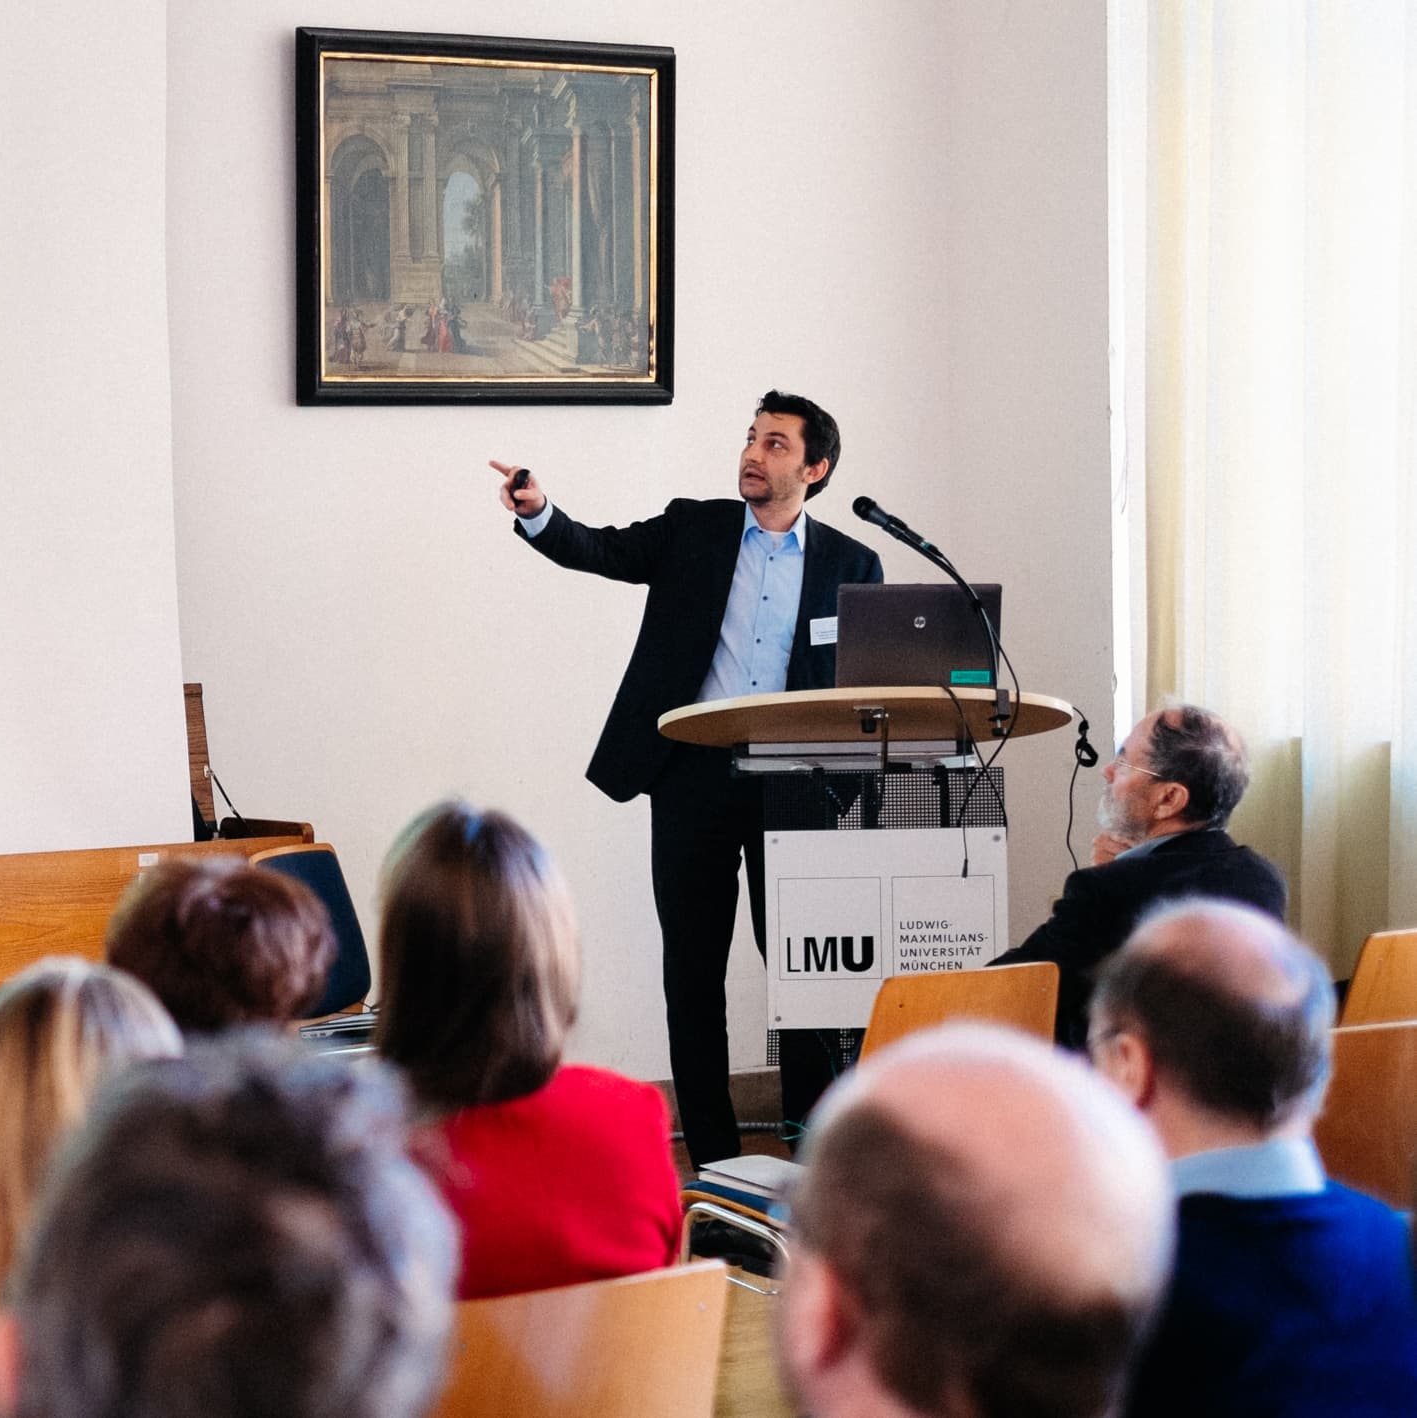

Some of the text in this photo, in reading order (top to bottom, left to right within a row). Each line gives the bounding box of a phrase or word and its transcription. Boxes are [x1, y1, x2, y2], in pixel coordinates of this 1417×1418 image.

[899, 919, 953, 930] LUDWIG-
[899, 932, 988, 944] MAXIMILIANS-
[786, 935, 875, 973] LMU
[899, 945, 982, 958] UNIVERSITÄT
[899, 959, 965, 972] MÜNCHEN
